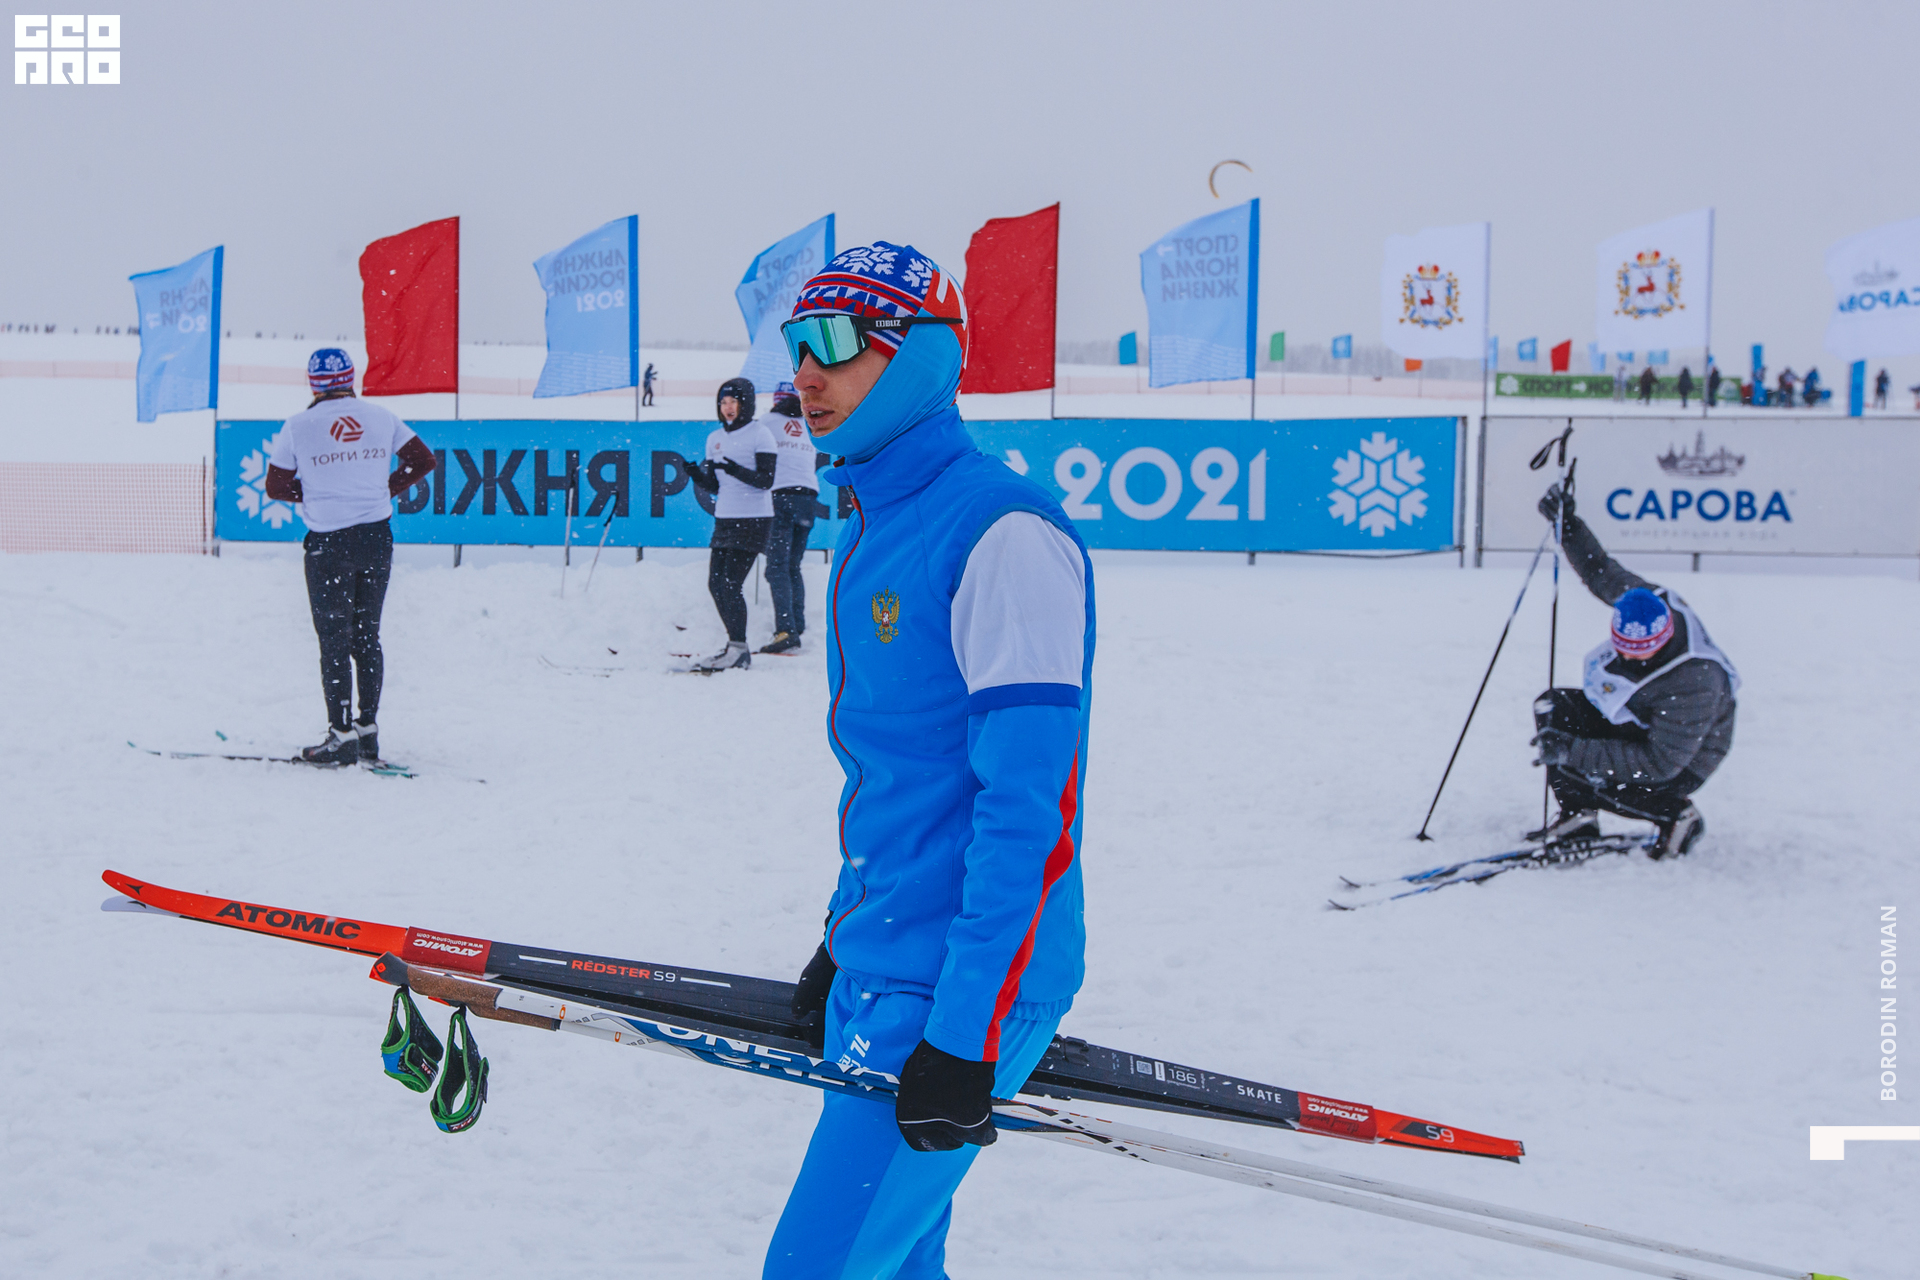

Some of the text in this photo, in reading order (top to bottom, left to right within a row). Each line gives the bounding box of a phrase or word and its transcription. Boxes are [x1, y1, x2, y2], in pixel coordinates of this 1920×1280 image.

[311, 448, 386, 467] ТОРГИ 223
[397, 448, 630, 518] ЫЖНЯ
[1054, 446, 1268, 521] 2021
[1606, 487, 1793, 522] САРОВА
[215, 902, 361, 940] ATOMIC
[413, 938, 483, 957] ATOMIC
[653, 970, 677, 983] S9
[1168, 1068, 1197, 1084] 186
[1236, 1084, 1283, 1104] SKATE
[1307, 1103, 1370, 1123] ATOMIC
[1425, 1124, 1455, 1143] S9
